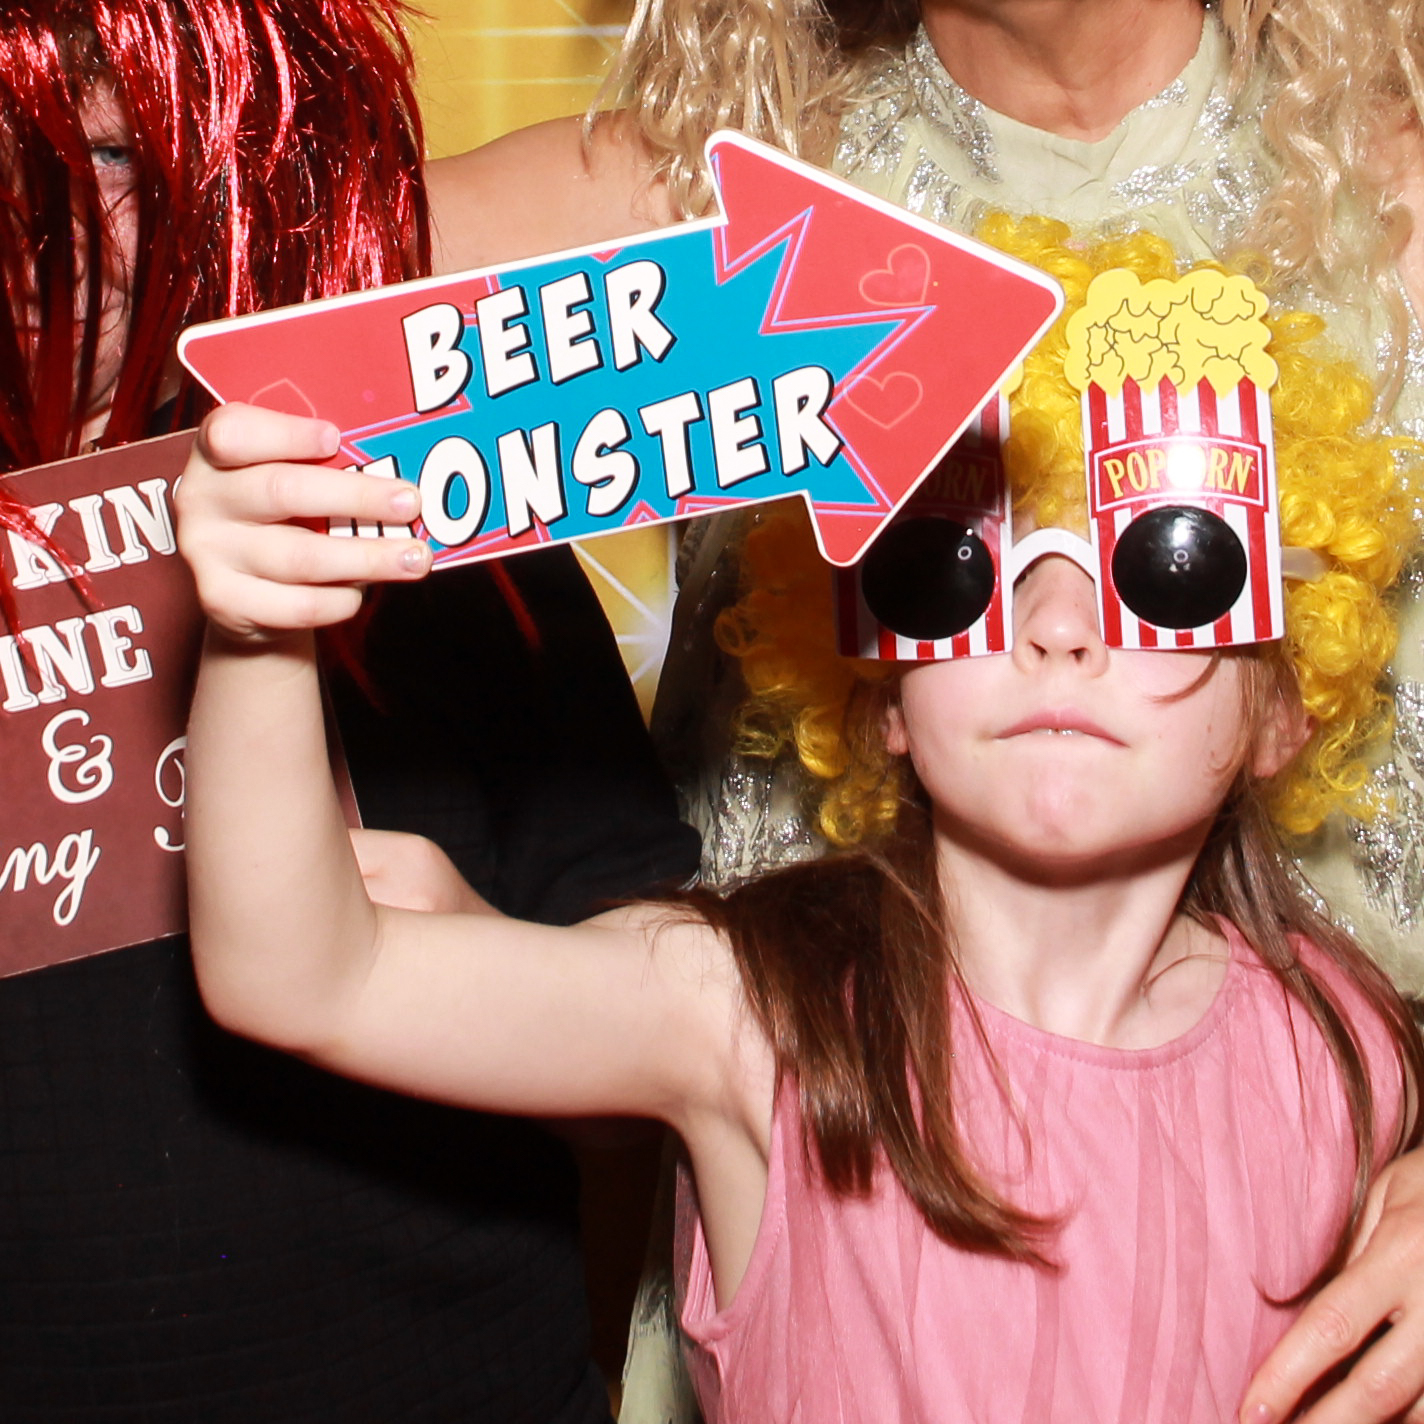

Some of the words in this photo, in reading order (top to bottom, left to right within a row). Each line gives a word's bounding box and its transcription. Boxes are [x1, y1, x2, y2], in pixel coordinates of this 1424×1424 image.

[401, 259, 675, 413] BEER
[1103, 447, 1254, 498] POPRN
[41, 709, 114, 804] &
